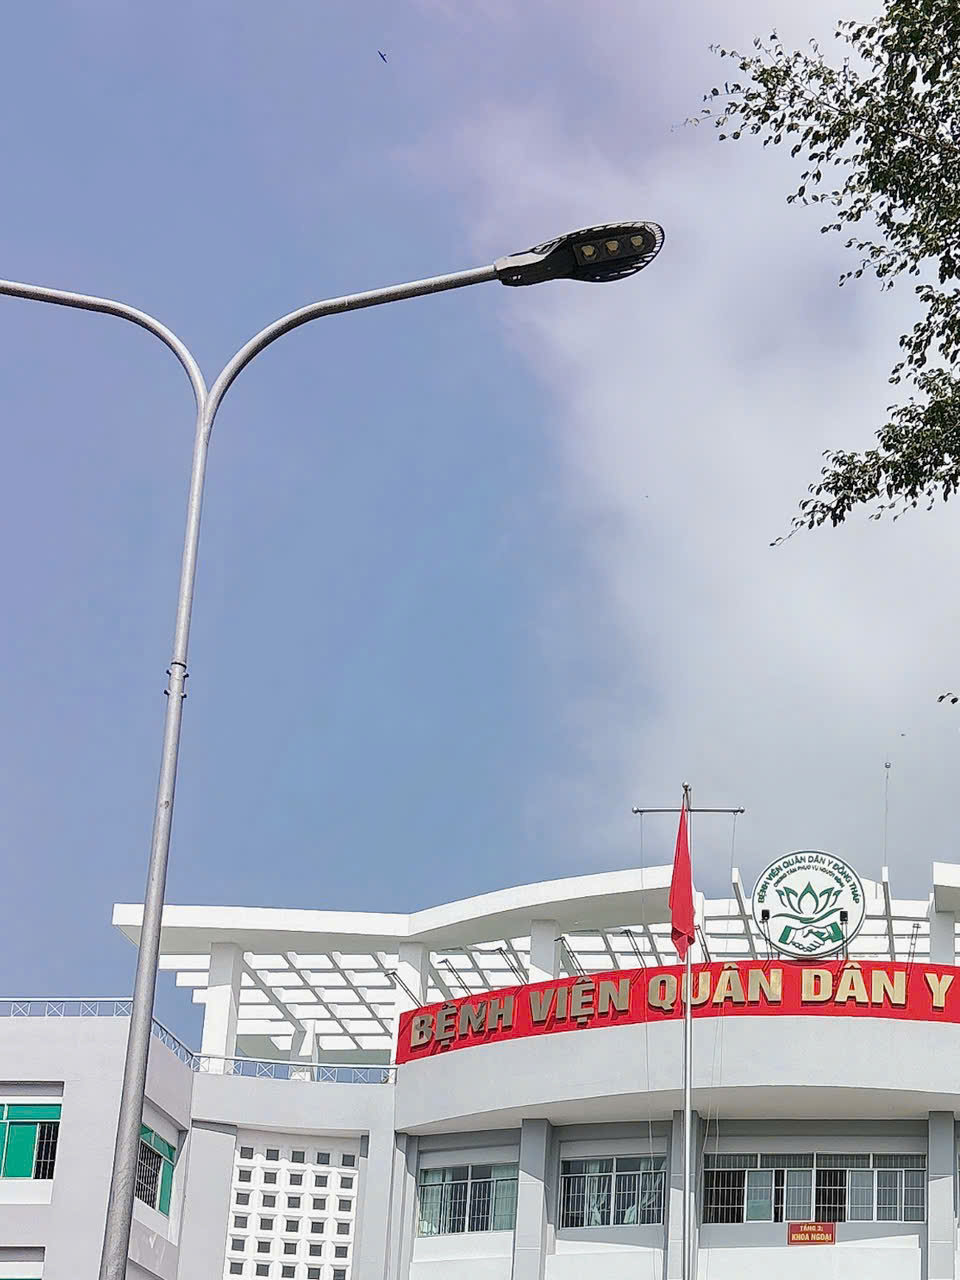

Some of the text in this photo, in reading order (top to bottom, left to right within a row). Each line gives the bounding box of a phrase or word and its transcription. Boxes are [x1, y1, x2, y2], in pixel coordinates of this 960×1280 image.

[757, 880, 770, 903] BỆNH
[766, 865, 783, 880] VIỆN
[782, 855, 806, 868] QUÂN
[808, 854, 826, 864] DÂN
[832, 863, 852, 883] ĐỒNG
[849, 882, 861, 904] THÁP
[410, 996, 514, 1050] BỆNH
[530, 976, 630, 1027] VIỆN
[647, 963, 783, 1010] QUÂN
[801, 961, 906, 1005] DÂN
[925, 974, 954, 1009] Y
[811, 1233, 832, 1242] NGOẠI
